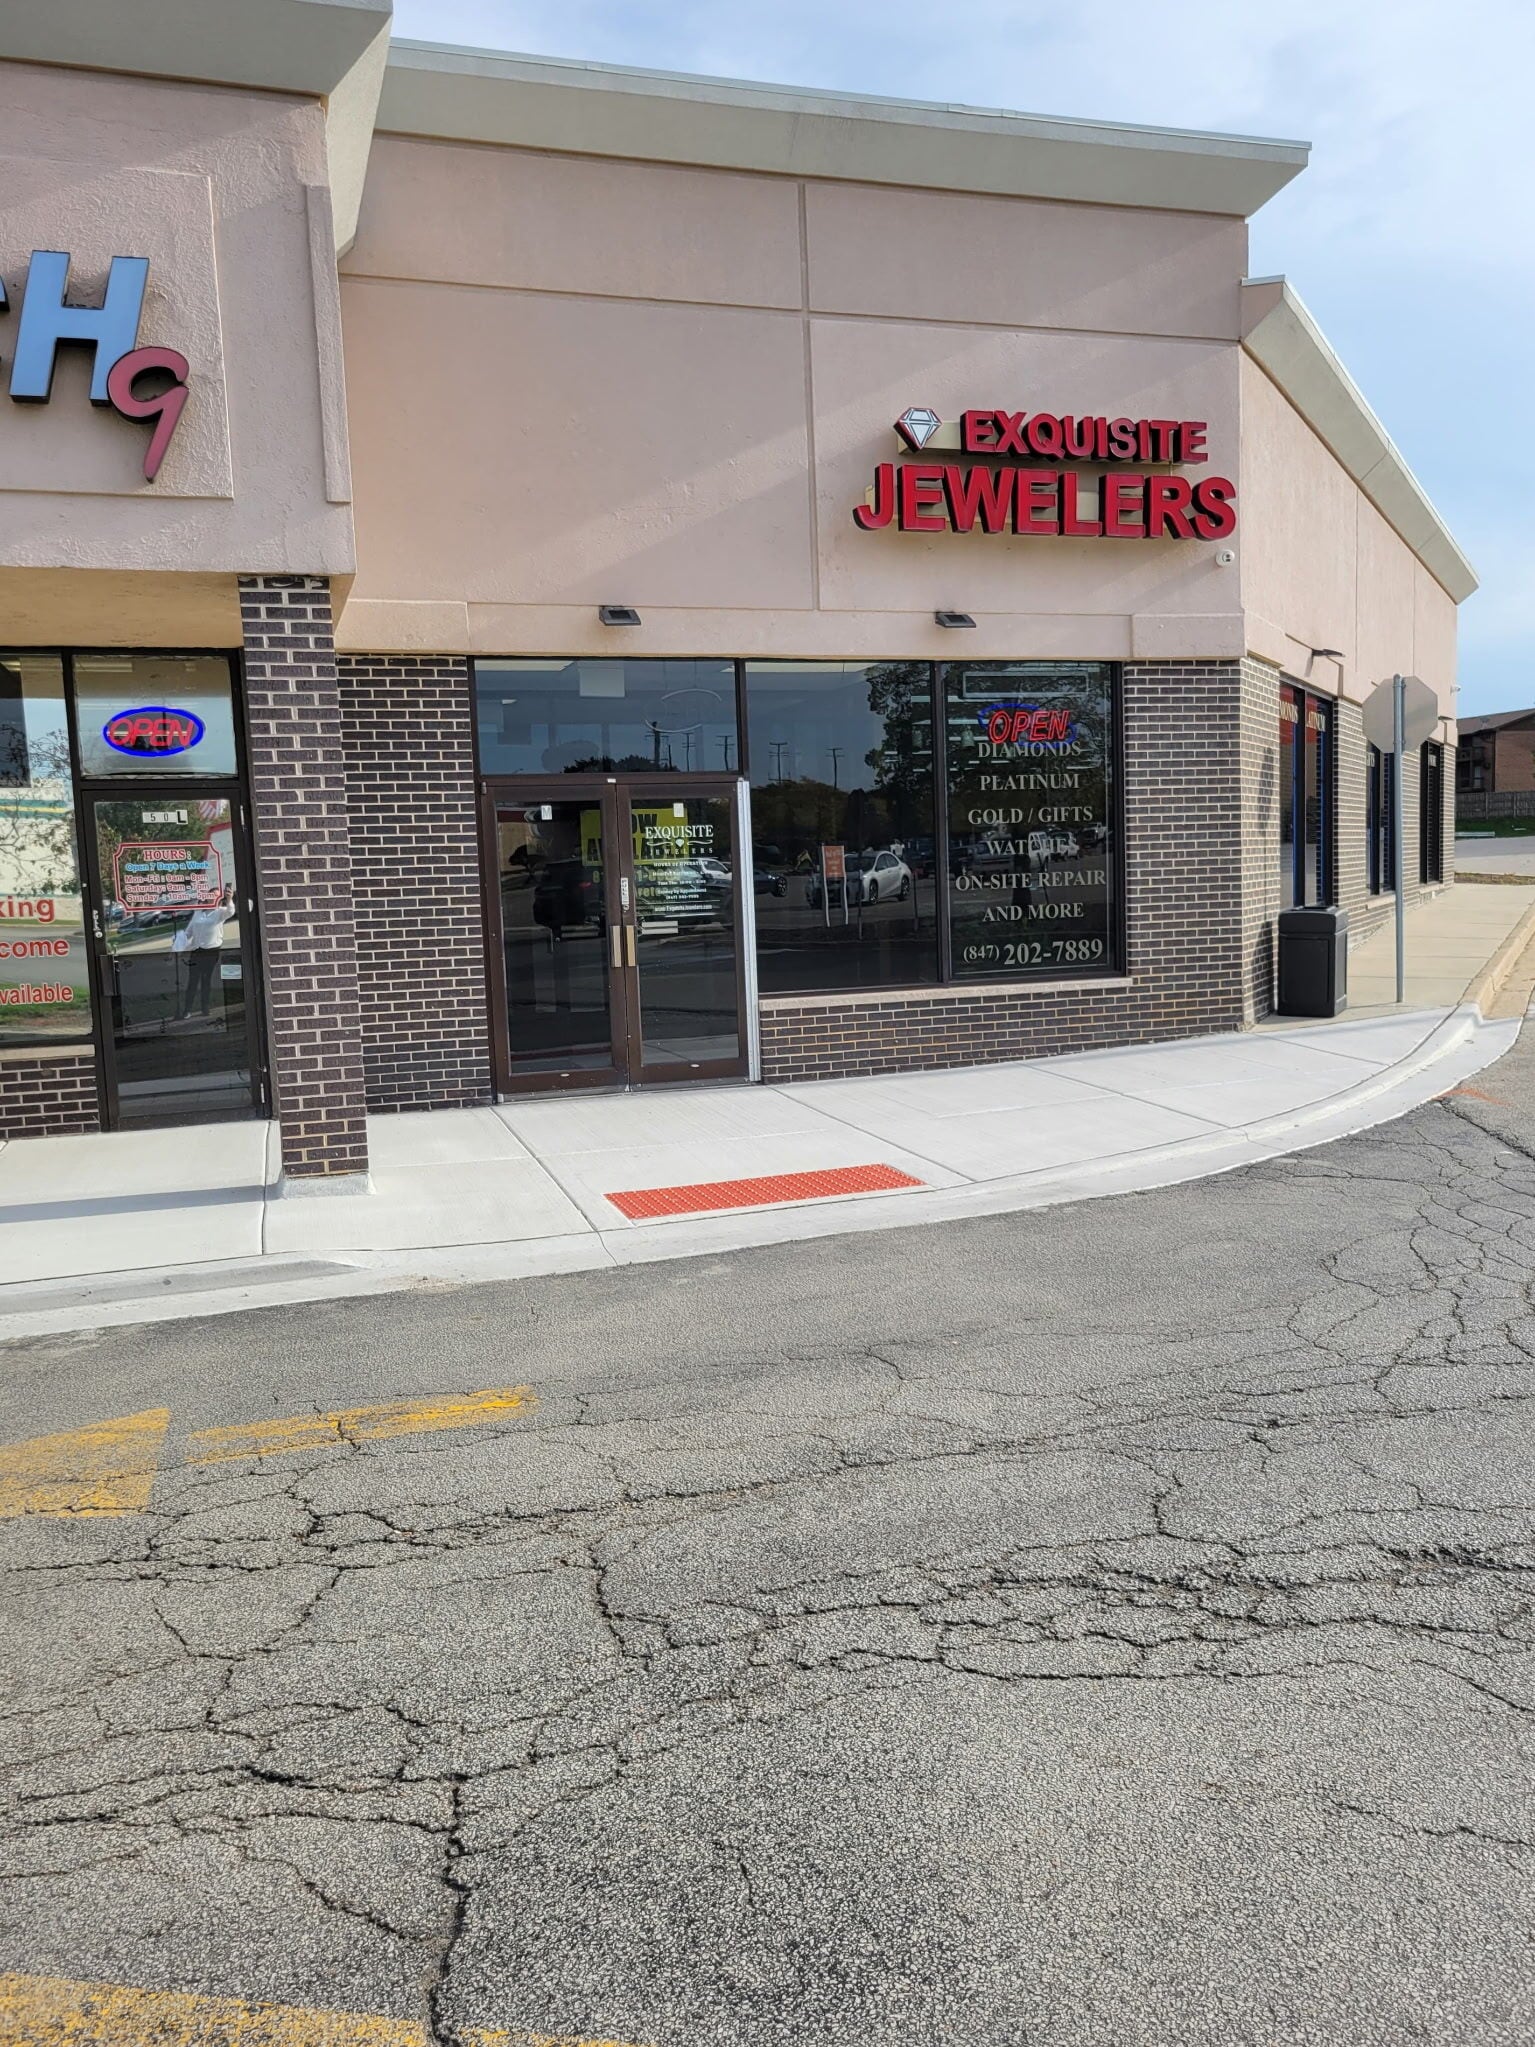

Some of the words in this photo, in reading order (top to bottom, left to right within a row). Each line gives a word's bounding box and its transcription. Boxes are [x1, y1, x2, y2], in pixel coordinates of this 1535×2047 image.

[961, 409, 1209, 464] EXQUISITE
[852, 462, 1237, 542] JEWELERS
[109, 717, 195, 748] OPEN
[988, 709, 1070, 744] OPEN
[977, 741, 1082, 759] DIAMONDS
[980, 773, 1080, 791] PLATINUM
[968, 807, 1024, 826] GOLD
[1038, 805, 1093, 823] GIFTS
[645, 824, 714, 839] EXQUISITE
[987, 836, 1078, 856] WATCHES
[125, 863, 149, 873] Open
[156, 862, 179, 872] Days
[187, 861, 211, 870] Week
[166, 874, 185, 882] 9am
[190, 873, 209, 883] 8pm
[167, 883, 186, 891] 9am
[956, 871, 1033, 893] ON-SITE
[1037, 869, 1106, 888] REPAIR
[127, 893, 160, 904] Sunday
[168, 892, 190, 901] 10am
[197, 891, 215, 901] 5pm
[982, 904, 1023, 923] AND
[1027, 901, 1084, 921] MORE
[963, 943, 1000, 964] (847)
[1003, 937, 1104, 966] 202-7889
